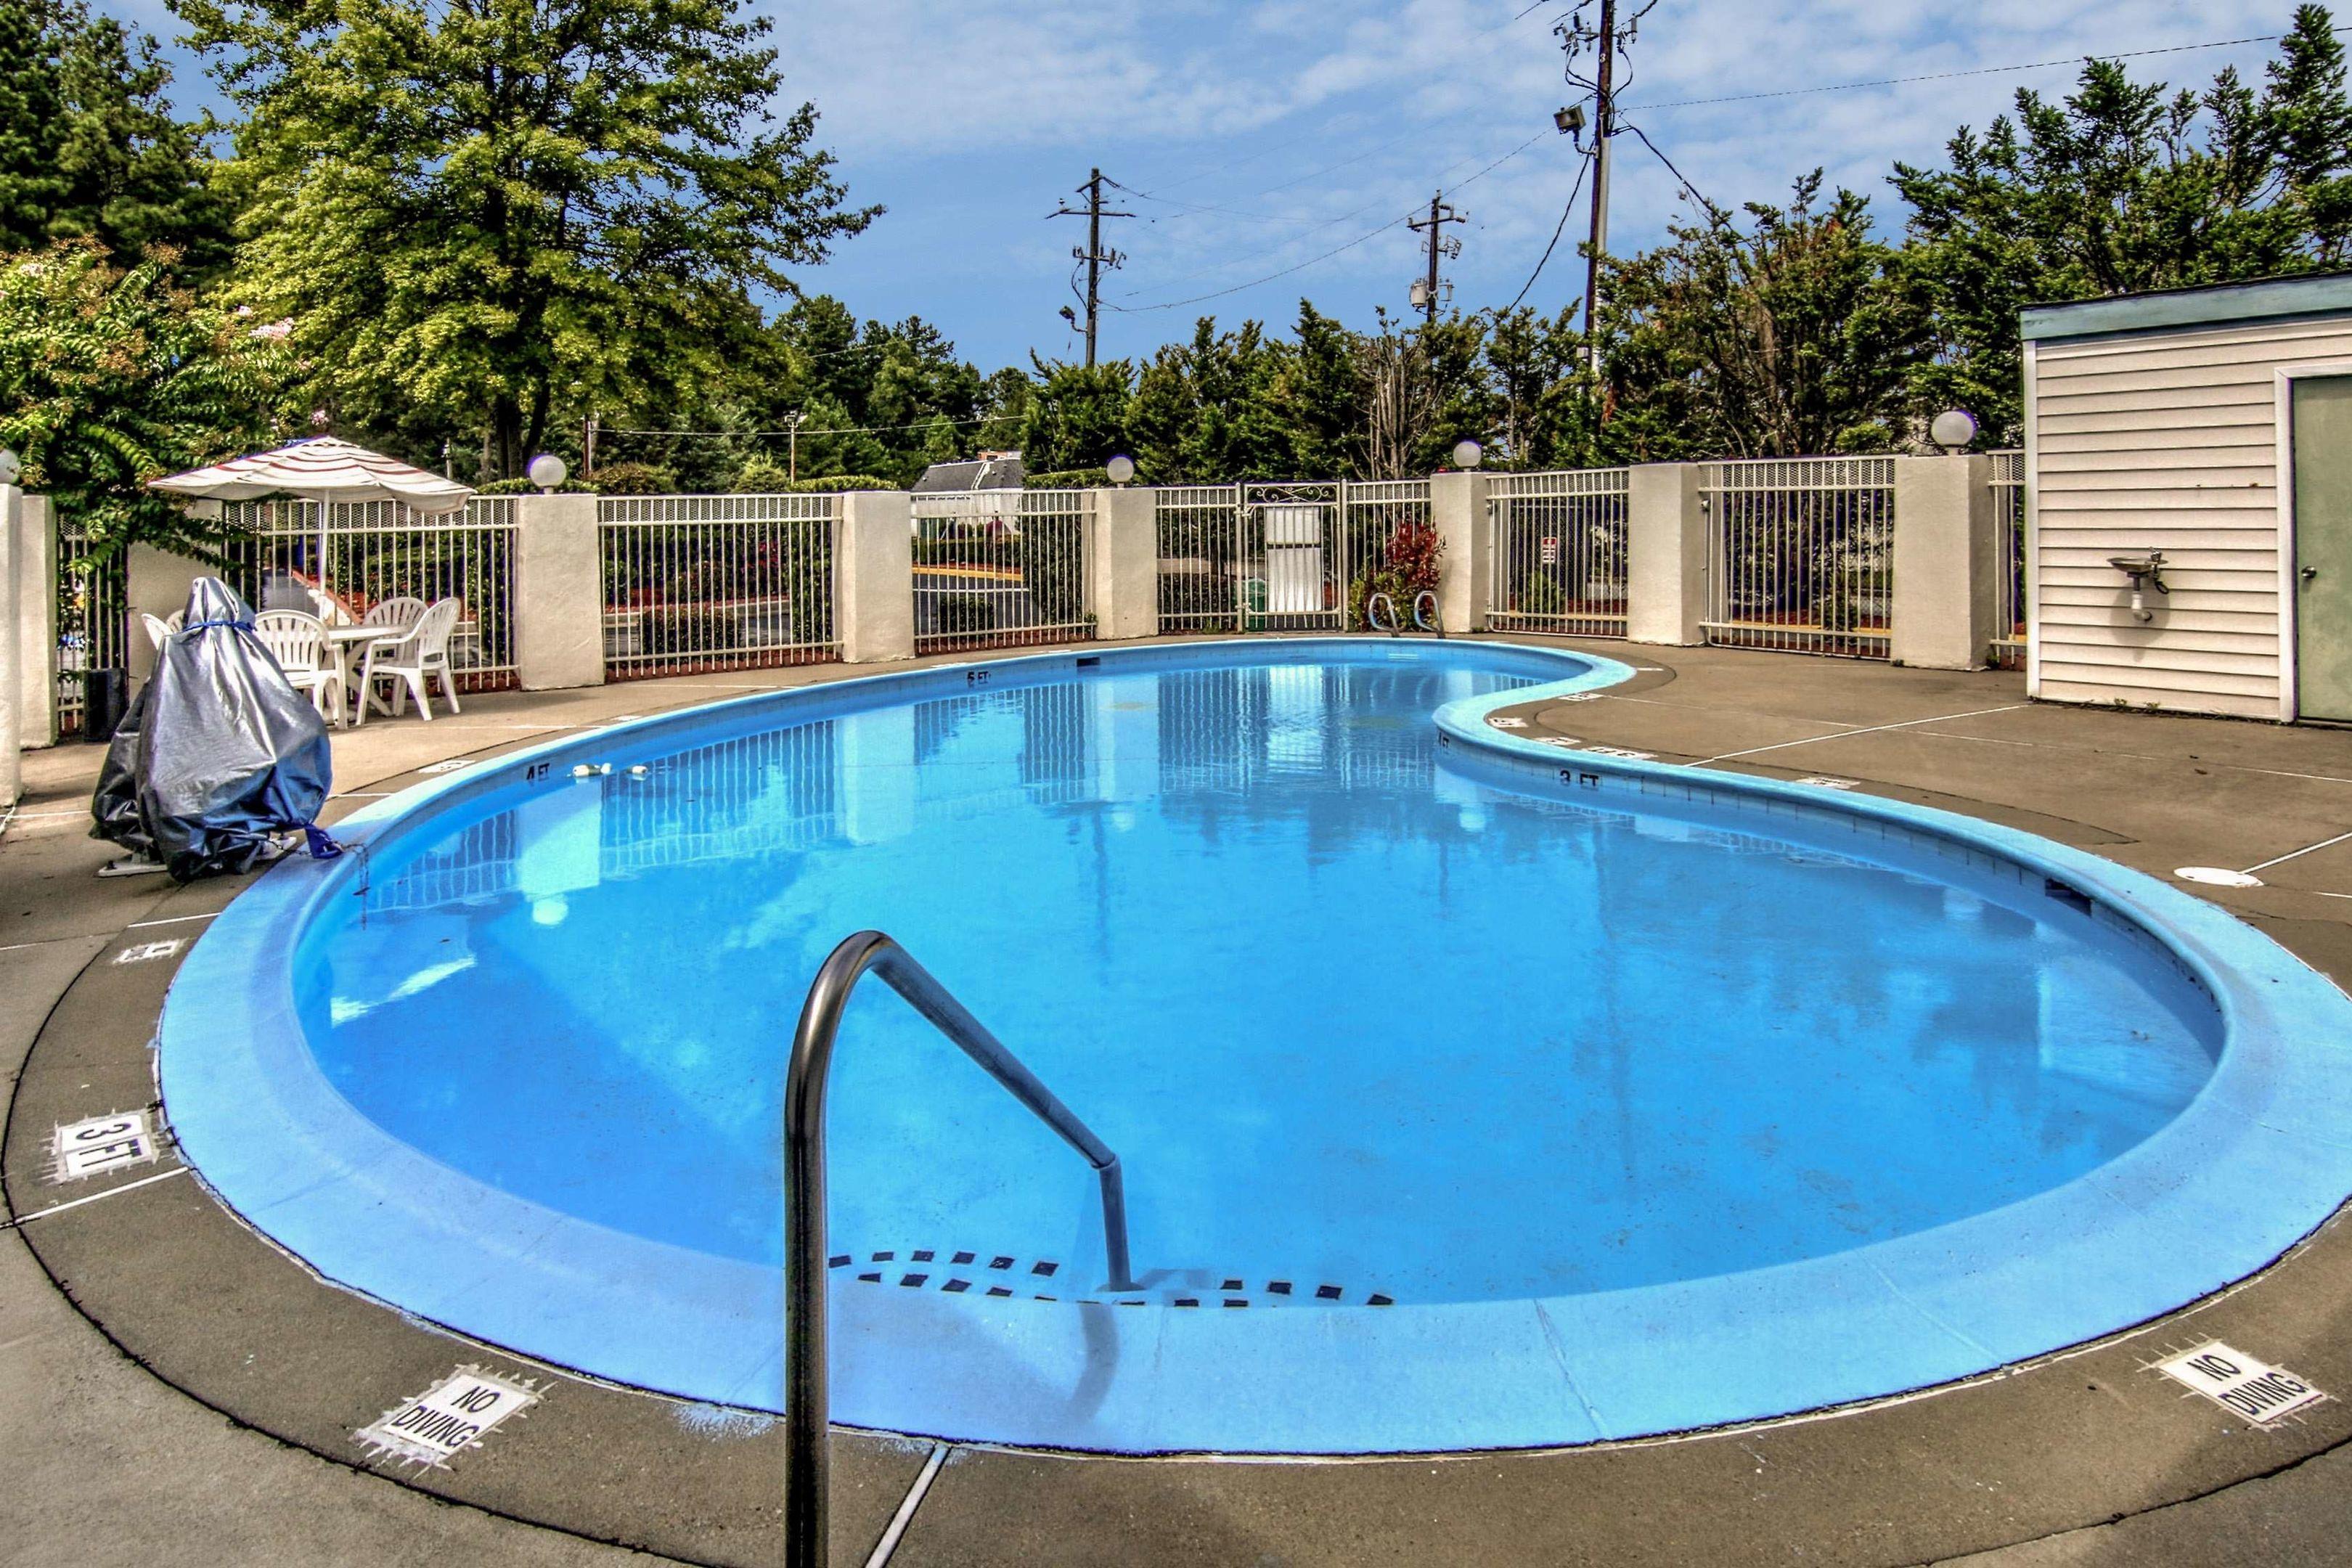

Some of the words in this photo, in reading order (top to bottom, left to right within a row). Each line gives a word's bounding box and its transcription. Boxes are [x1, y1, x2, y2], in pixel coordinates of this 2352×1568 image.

[1580, 773, 1598, 786] FT
[75, 1123, 132, 1140] 3
[78, 1138, 143, 1167] FT
[2186, 1355, 2242, 1381] NO
[451, 1386, 501, 1413] NO
[2218, 1372, 2309, 1416] DIVING
[391, 1405, 480, 1447] DIVING
